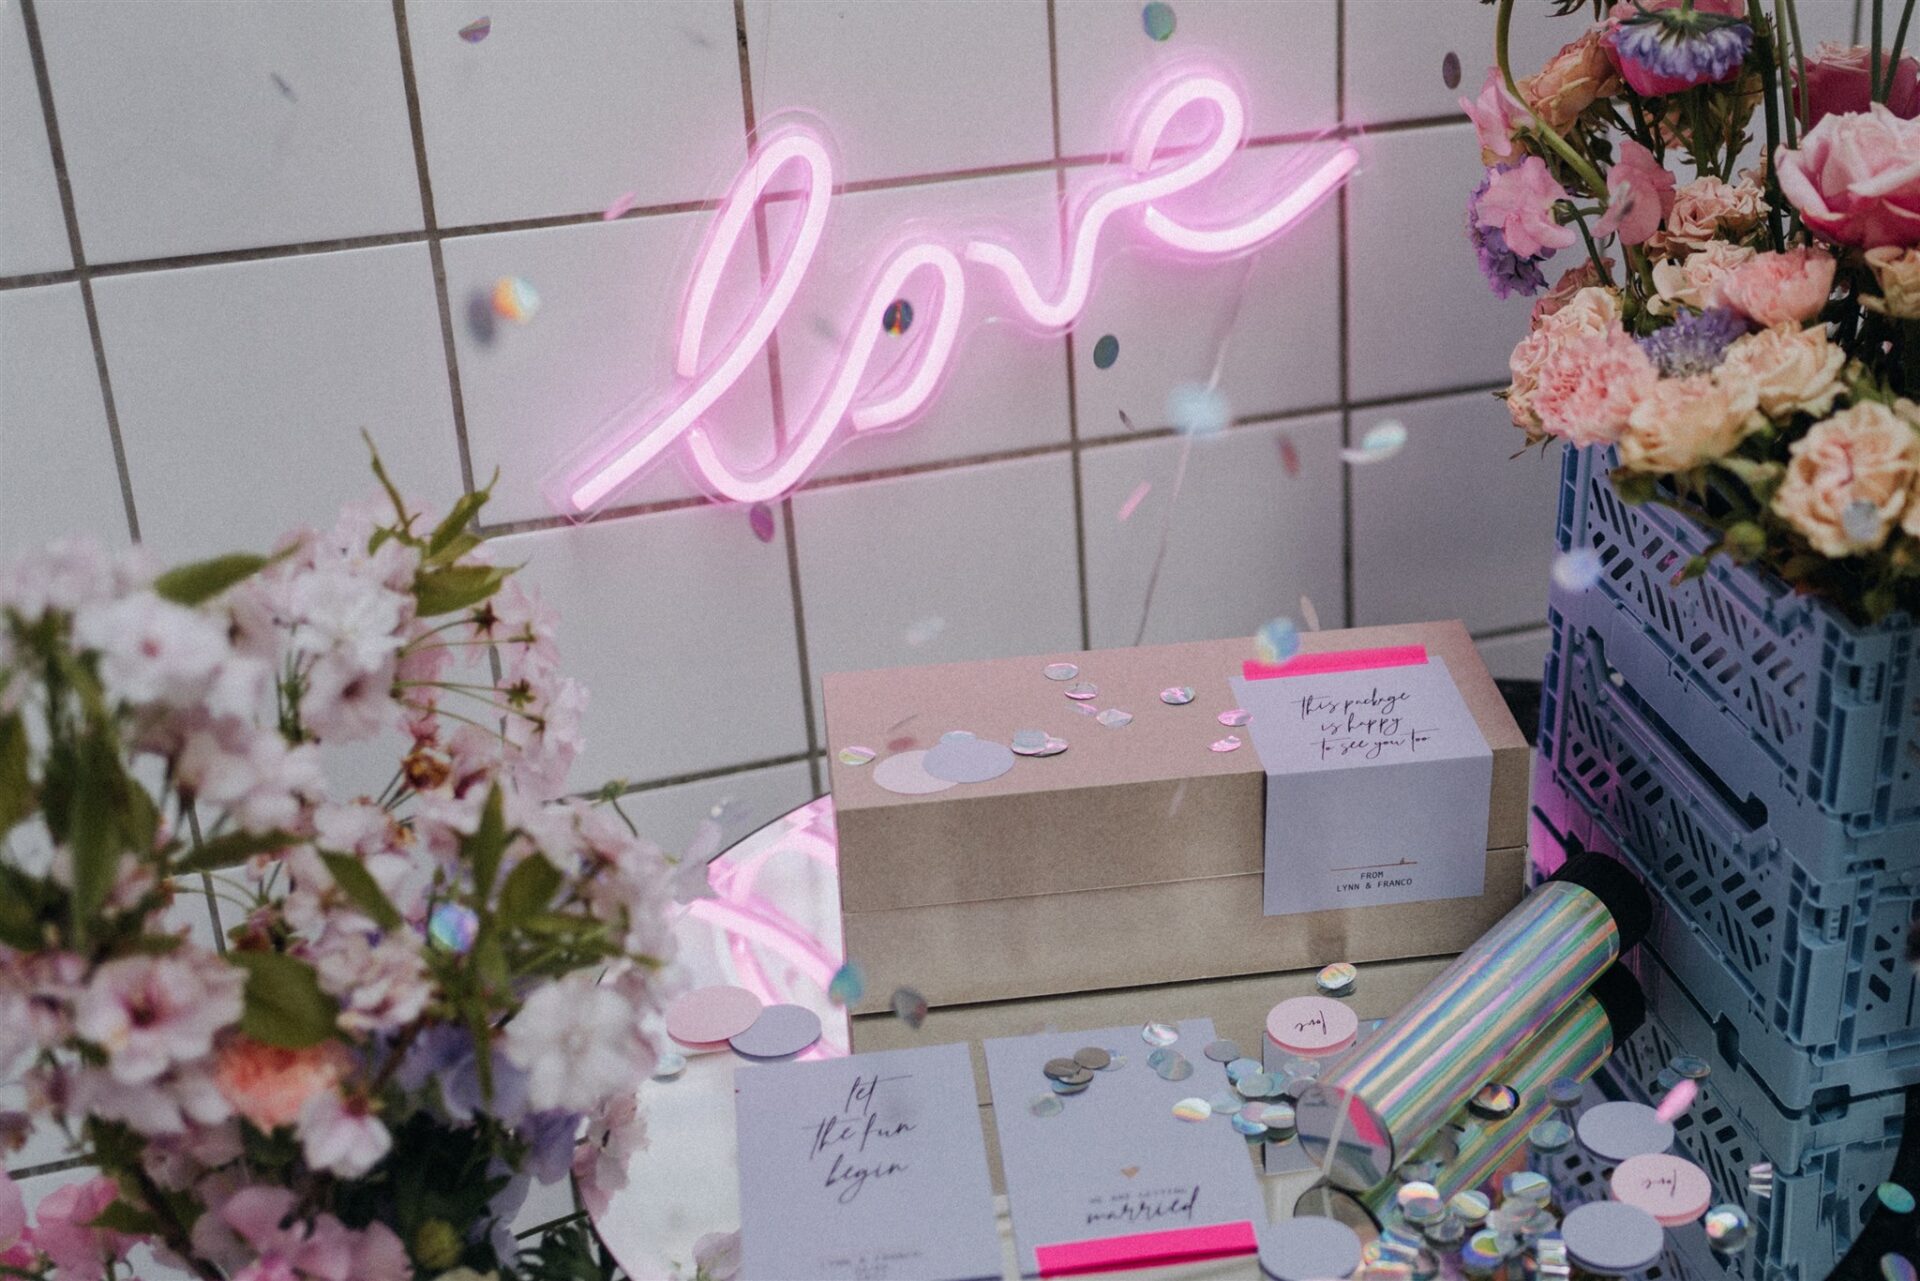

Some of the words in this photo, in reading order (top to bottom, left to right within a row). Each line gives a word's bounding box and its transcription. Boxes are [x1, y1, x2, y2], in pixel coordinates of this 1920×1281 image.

[570, 74, 1360, 513] love
[1290, 695, 1341, 720] this
[1343, 687, 1411, 715] package
[1321, 722, 1343, 735] is
[1347, 712, 1404, 736] happy
[1340, 740, 1369, 756] see
[1365, 739, 1406, 760] you
[1400, 728, 1440, 752] too
[1336, 883, 1360, 893] LYNN
[1365, 882, 1372, 890] &
[1377, 878, 1413, 888] FRANCO
[1360, 871, 1384, 880] FROM
[1294, 1009, 1327, 1036] love
[844, 1074, 913, 1116] let
[801, 1115, 862, 1160] the
[859, 1112, 917, 1152] fun
[825, 1153, 909, 1203] begin
[1086, 1185, 1199, 1224] married
